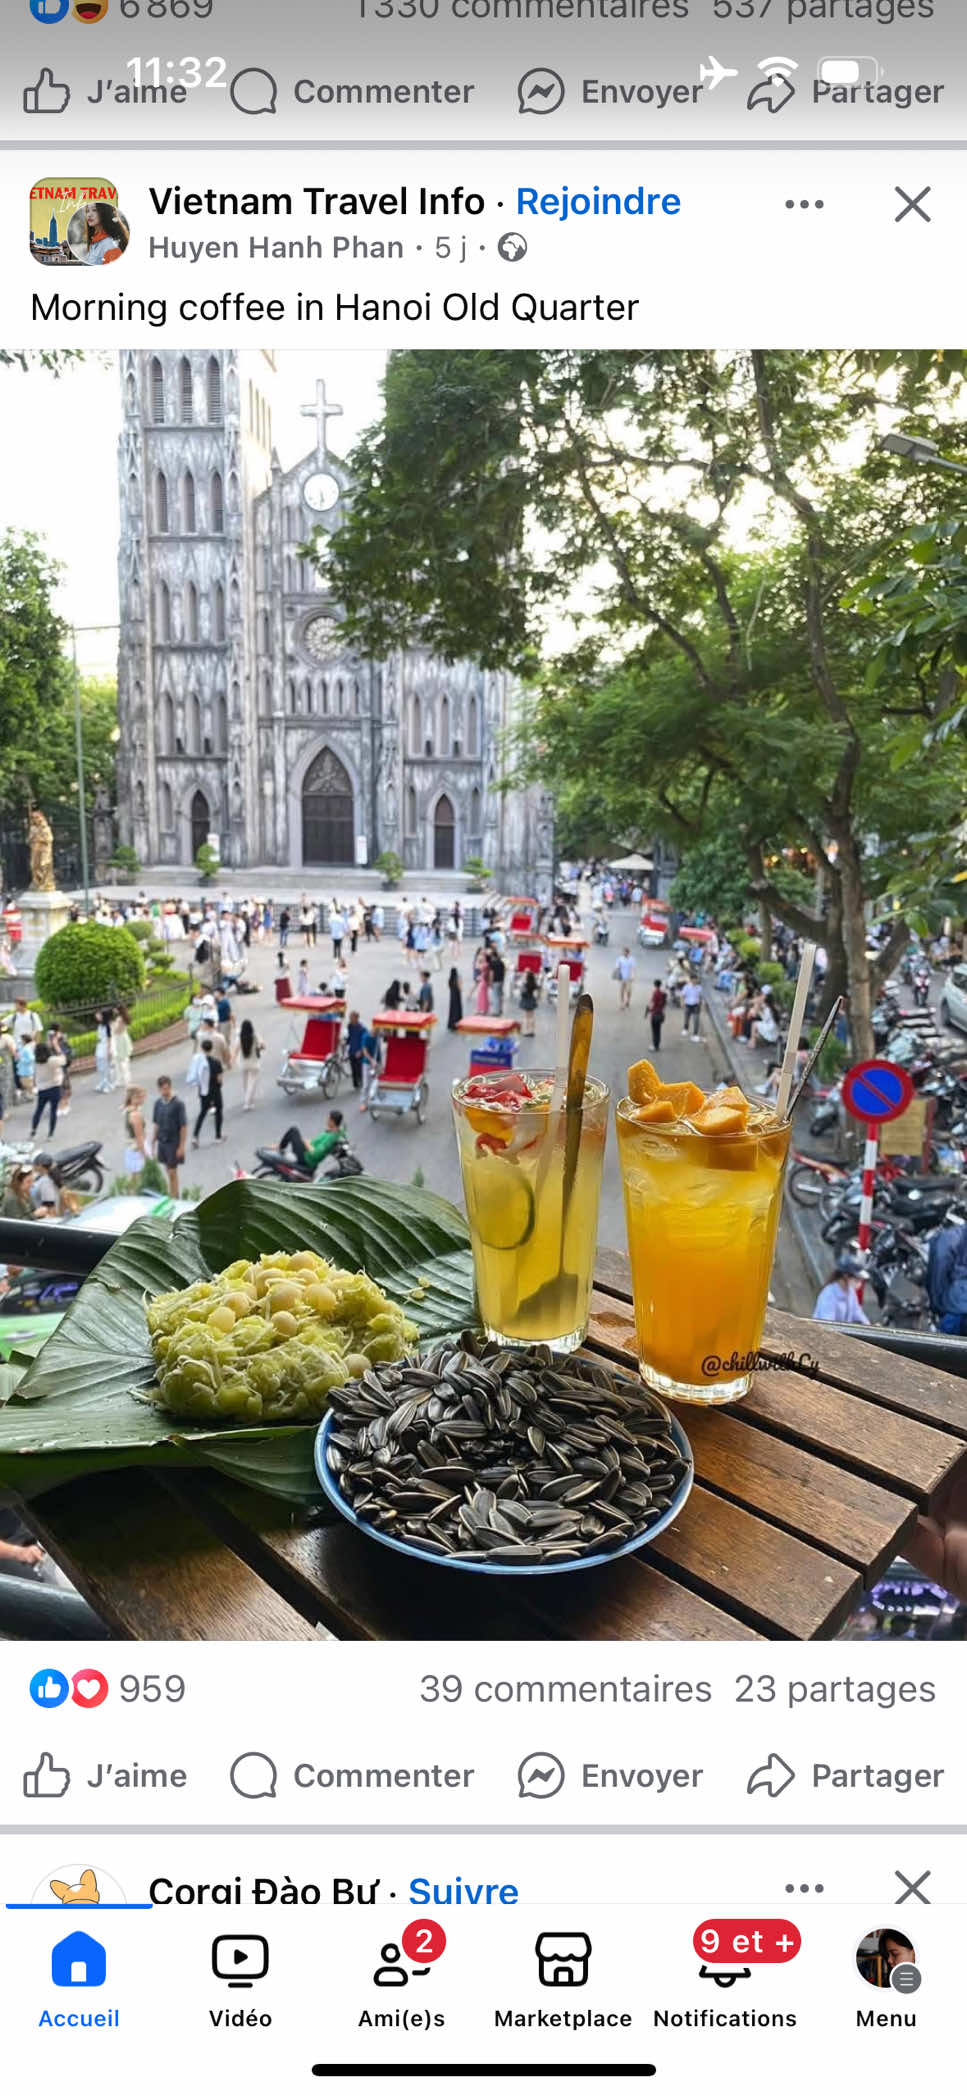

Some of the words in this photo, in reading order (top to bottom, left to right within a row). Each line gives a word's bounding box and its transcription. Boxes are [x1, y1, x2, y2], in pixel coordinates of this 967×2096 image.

[452, 0, 688, 18] commentaires
[788, 0, 934, 24] partages
[127, 56, 227, 88] 11:32
[294, 79, 475, 104] Commenter
[583, 80, 703, 109] Envoyer
[813, 79, 945, 109] Partager
[149, 185, 292, 215] Vietnam
[303, 186, 406, 215] Travel
[420, 186, 484, 215] Info
[518, 184, 680, 221] Rejoindre
[150, 236, 238, 263] Huyen
[250, 235, 322, 258] Hanh
[333, 235, 403, 258] Phan
[436, 236, 450, 258] 5
[460, 235, 466, 263] j
[33, 292, 166, 327] Morning
[180, 292, 285, 321] coffee
[297, 292, 323, 320] in
[337, 292, 430, 321] Hanoi
[443, 292, 498, 321] Old
[512, 293, 639, 323] Quarter
[120, 1675, 185, 1702] 959
[421, 1675, 462, 1702] 39
[475, 1674, 711, 1702] commentaires
[736, 1675, 775, 1702] 23
[789, 1677, 935, 1709] partages
[294, 1763, 475, 1788] Commenter
[583, 1764, 703, 1793] Envoyer
[814, 1764, 944, 1793] Partager
[252, 1876, 320, 1903] Đào
[333, 1878, 381, 1903] Bư
[409, 1876, 518, 1903] Suivre
[415, 1928, 434, 1953] 2
[700, 1929, 720, 1953] 9
[732, 1930, 763, 1953] et
[38, 2008, 120, 2029] Accueil
[209, 2008, 272, 2027] Vidéo
[358, 2009, 445, 2031] Ami(e)s
[495, 2009, 632, 2031] Marketplace
[654, 2009, 796, 2028] Notifications
[857, 2010, 916, 2027] Menu
